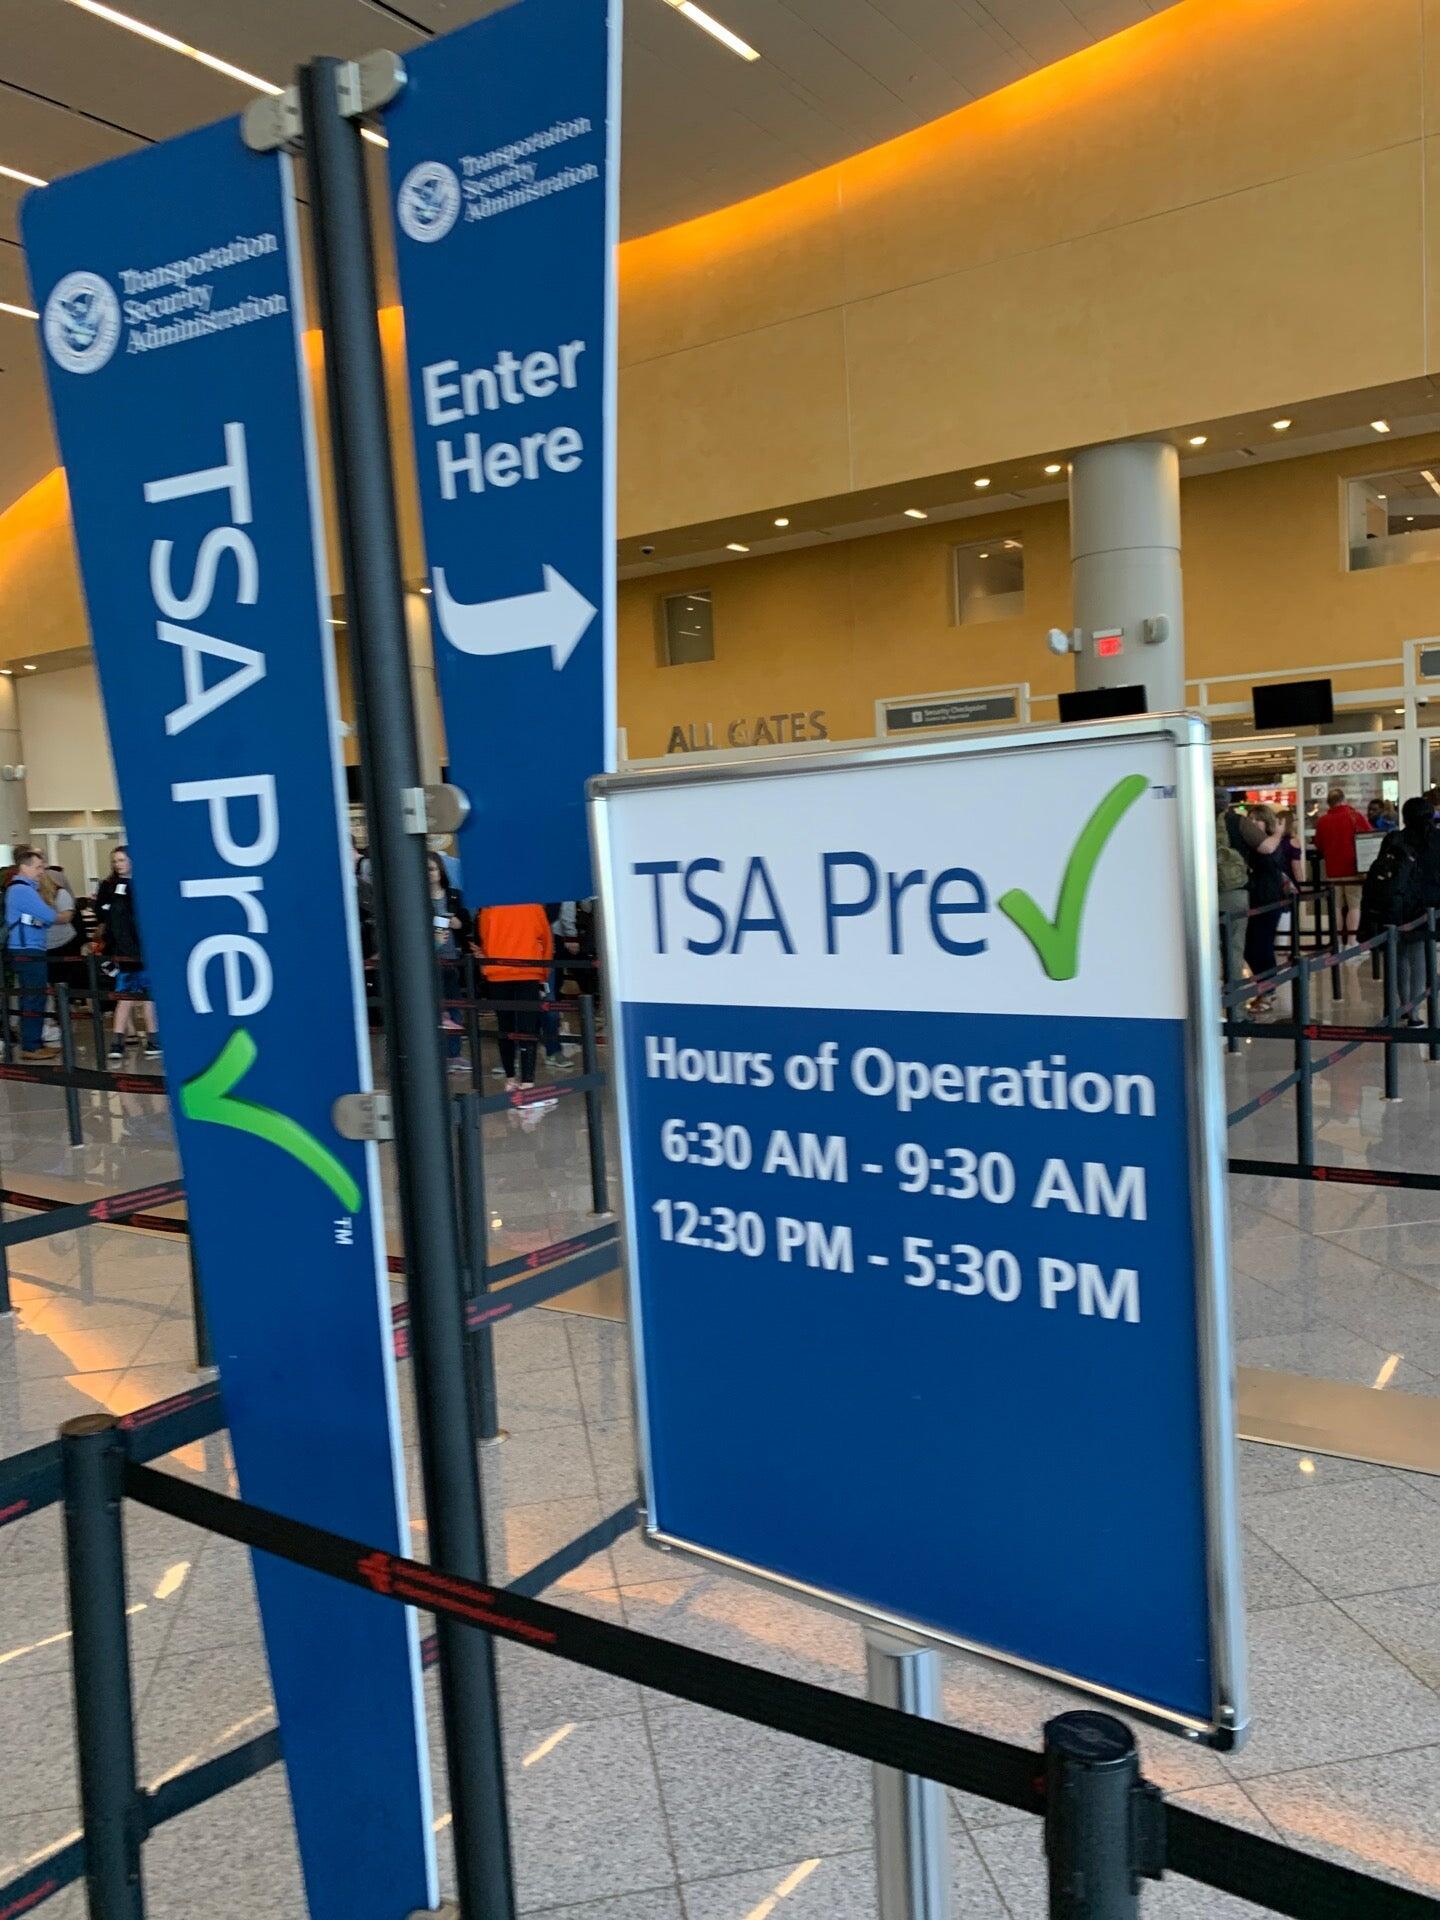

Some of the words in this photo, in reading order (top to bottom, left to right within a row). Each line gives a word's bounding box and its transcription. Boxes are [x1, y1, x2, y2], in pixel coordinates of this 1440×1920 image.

[459, 117, 592, 176] Transportation
[461, 162, 537, 199] Security
[464, 163, 599, 222] Administration
[119, 233, 279, 294] Transportation
[123, 284, 213, 324] Security
[126, 294, 288, 354] Administration
[421, 340, 586, 425] Enter
[437, 426, 584, 499] Here
[144, 422, 266, 735] TSA
[667, 721, 718, 754] ALL
[727, 710, 828, 748] GATES
[172, 774, 279, 1016] Pre
[632, 856, 798, 956] TSA
[820, 850, 990, 957] Pre
[645, 1036, 773, 1088] Hours
[785, 1042, 838, 1092] of
[851, 1047, 1156, 1117] Operation
[661, 1118, 752, 1171] 6:30
[762, 1129, 848, 1184] AM
[861, 1161, 884, 1174] -
[896, 1142, 1015, 1204] 9:30
[1031, 1158, 1147, 1221] AM
[652, 1198, 765, 1258] 12:30
[776, 1216, 854, 1273] PM
[867, 1254, 890, 1267] -
[903, 1236, 1022, 1302] 5:30
[1039, 1256, 1141, 1323] PM
